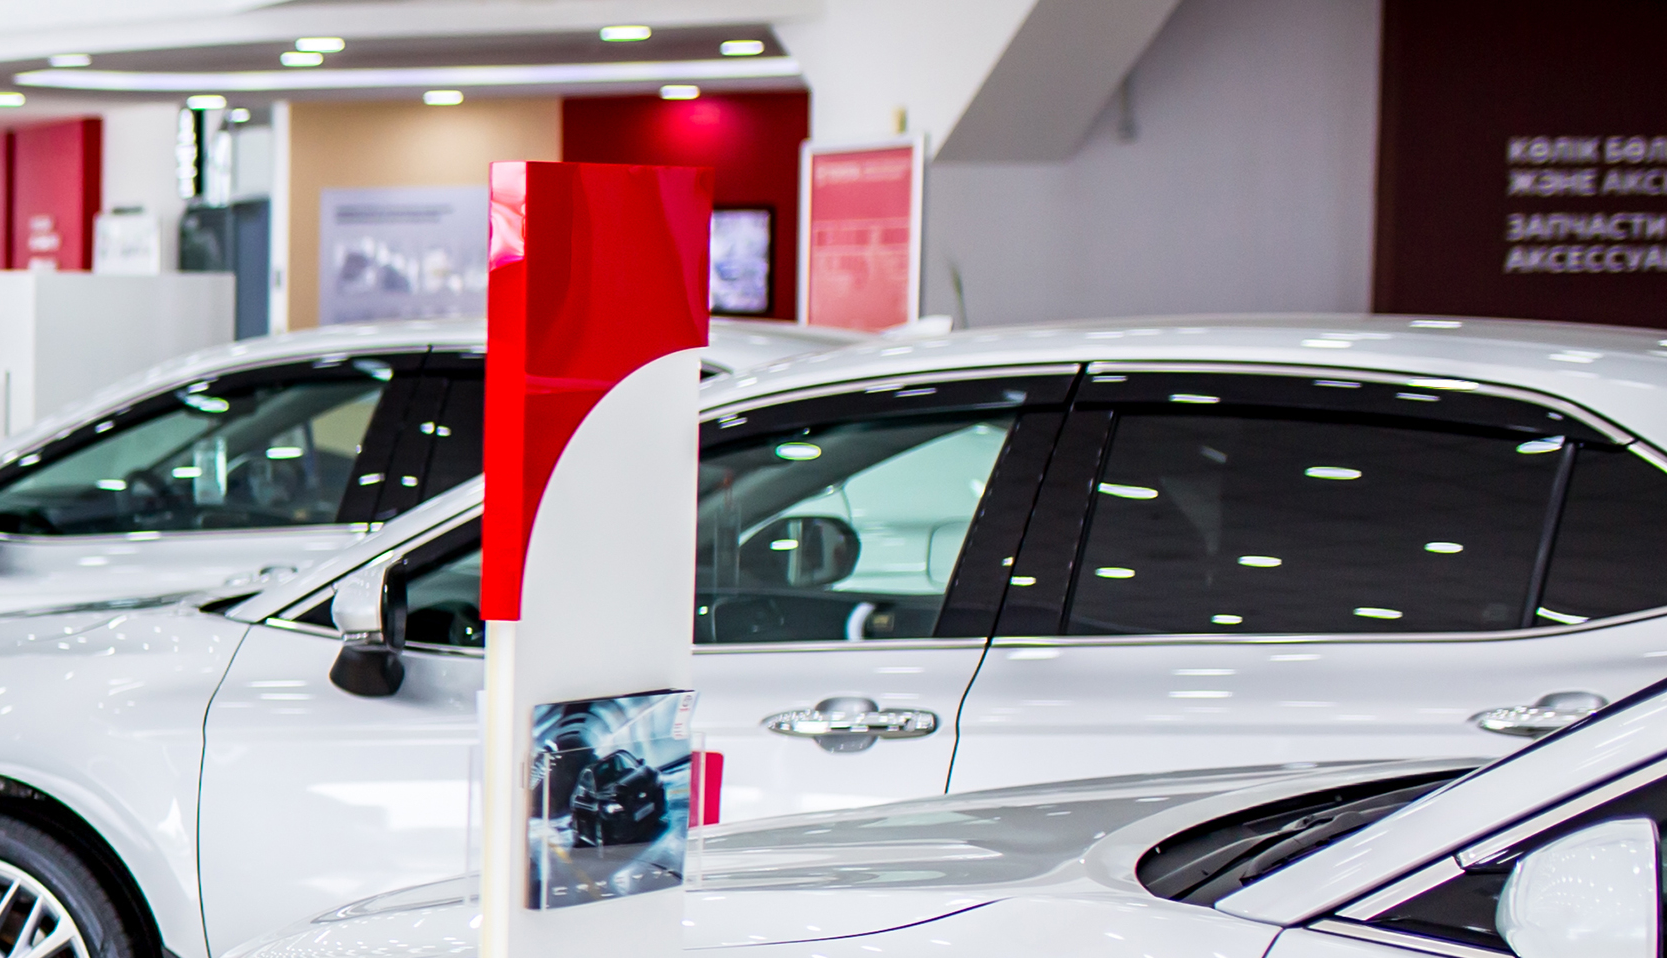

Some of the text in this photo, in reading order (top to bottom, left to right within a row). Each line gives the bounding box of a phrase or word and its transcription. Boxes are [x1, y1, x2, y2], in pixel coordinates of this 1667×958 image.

[1601, 168, 1667, 196] АКС
[1507, 213, 1667, 240] ЗАПЧАСТИ
[1503, 245, 1667, 273] АКСЕССУА
